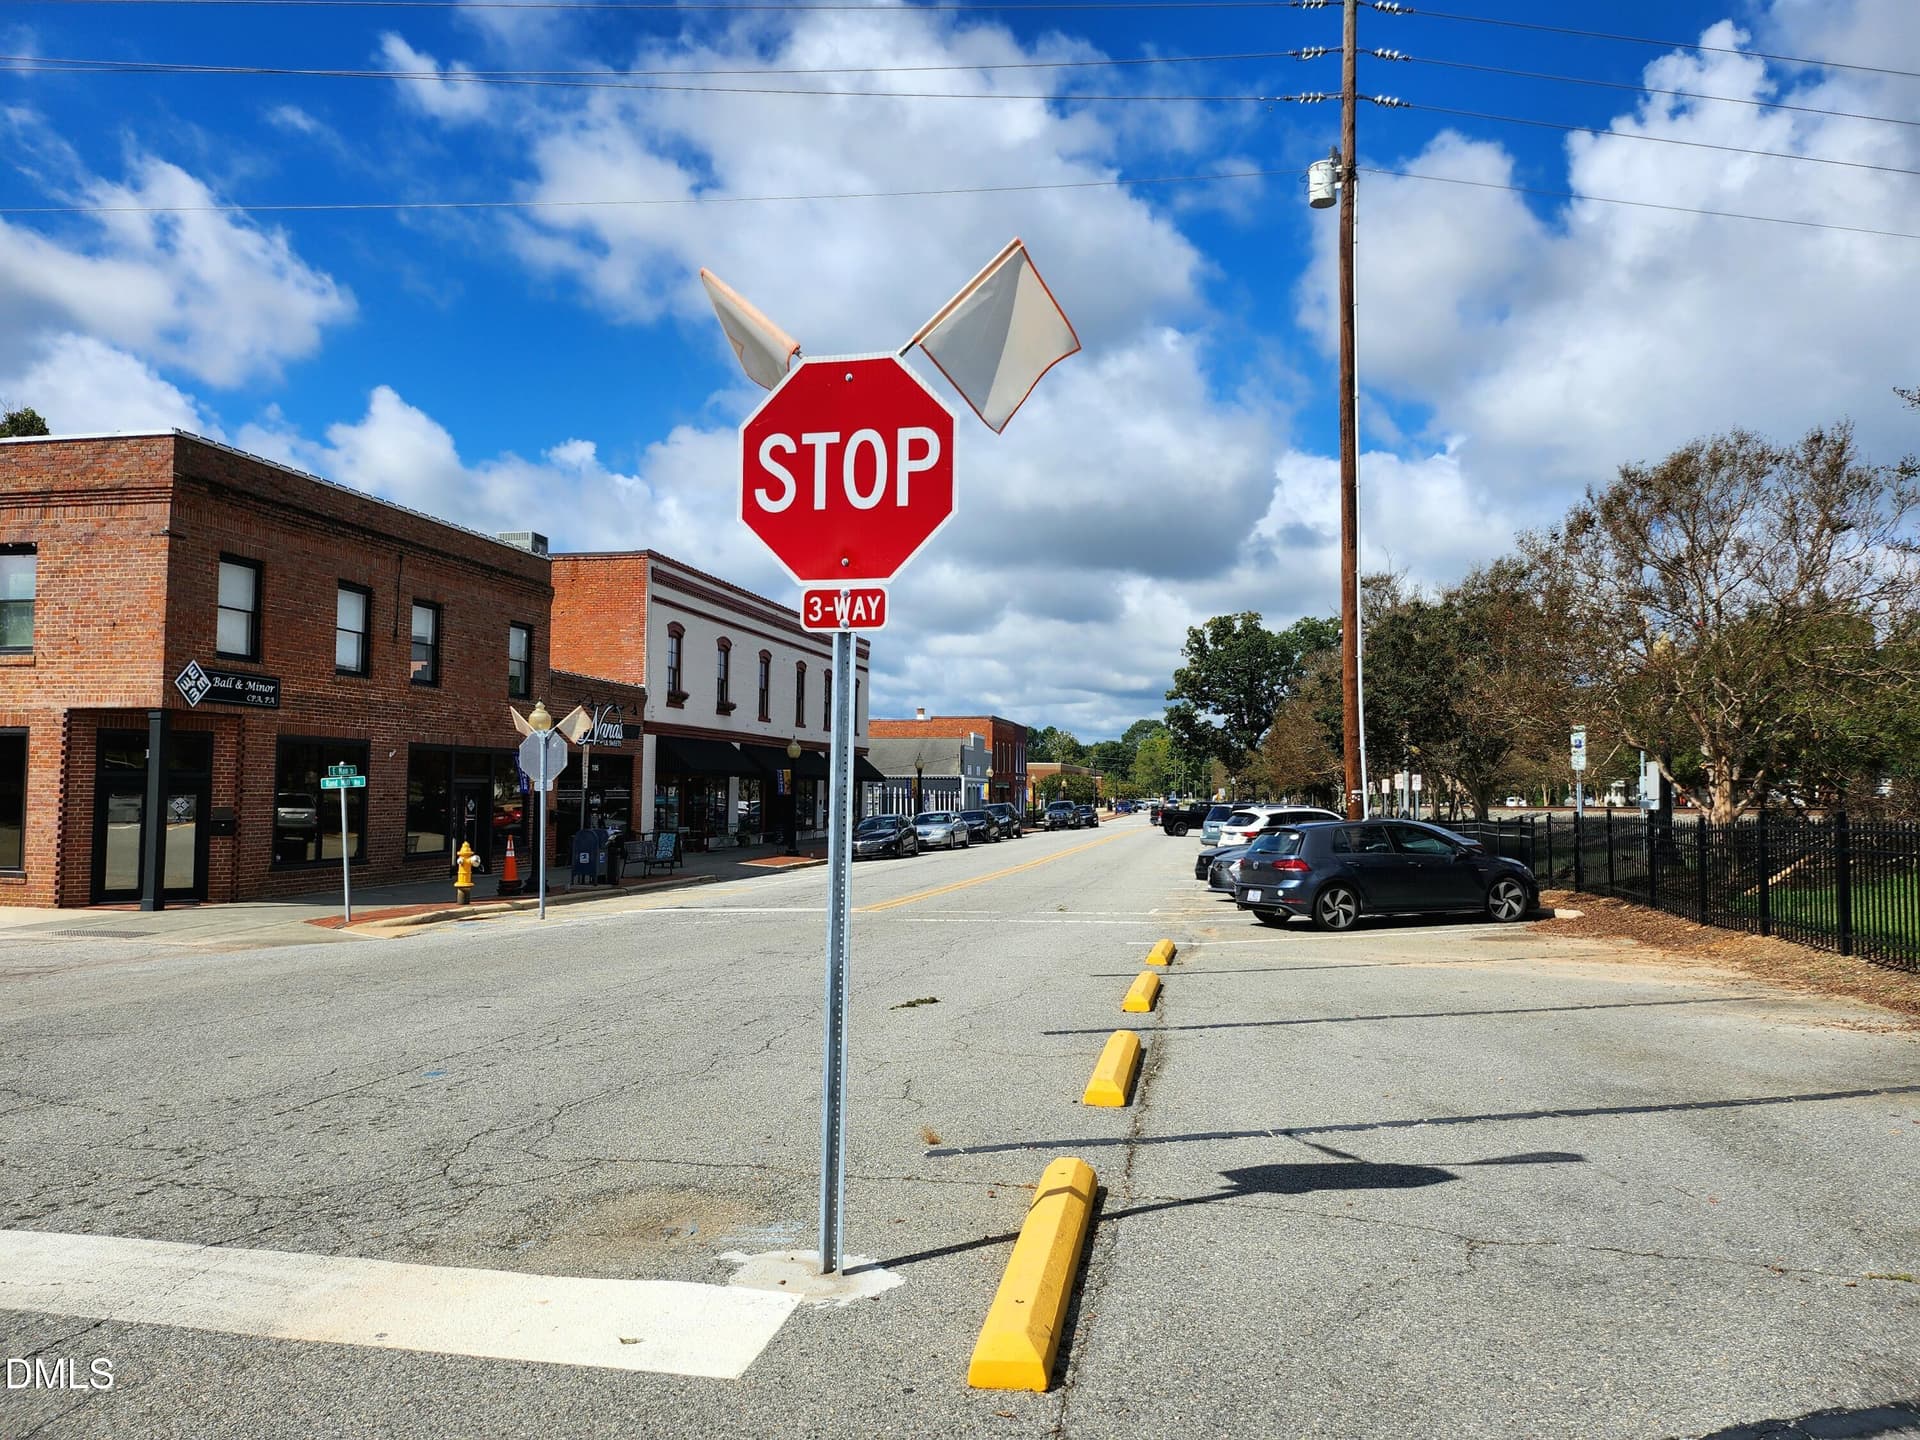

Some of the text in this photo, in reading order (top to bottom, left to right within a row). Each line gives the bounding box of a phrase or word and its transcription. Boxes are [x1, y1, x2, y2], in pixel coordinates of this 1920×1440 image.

[754, 426, 941, 513] STOP
[808, 595, 881, 622] 3-WAY
[212, 676, 276, 693] Ball & Minor
[264, 696, 276, 704] PA
